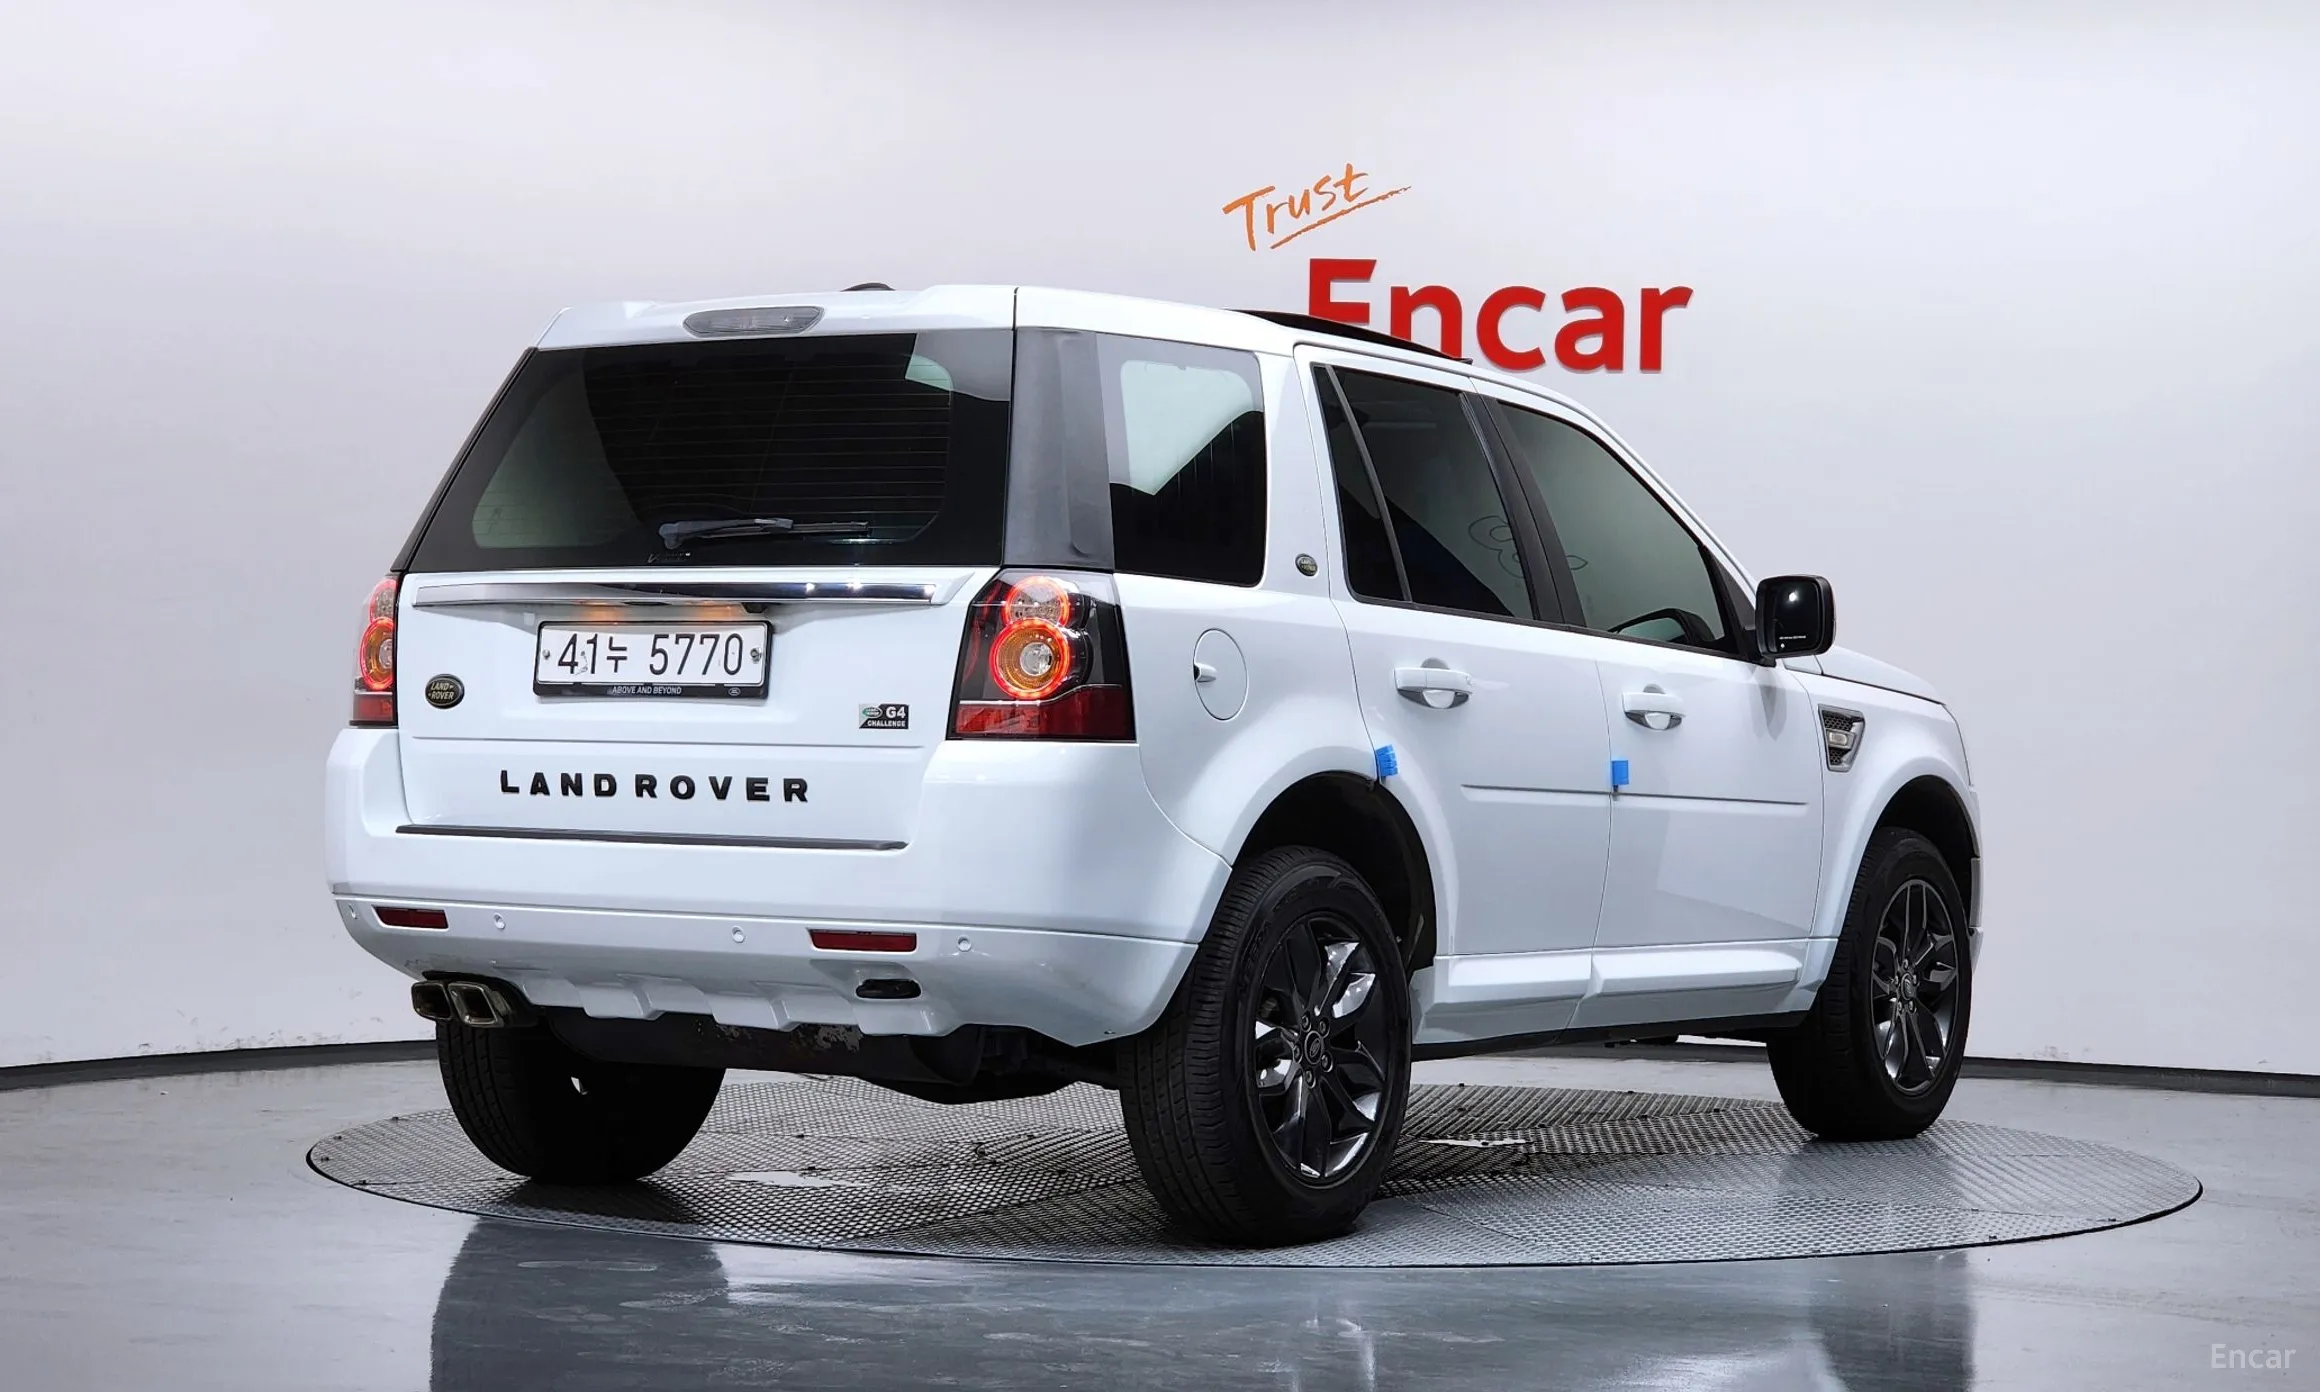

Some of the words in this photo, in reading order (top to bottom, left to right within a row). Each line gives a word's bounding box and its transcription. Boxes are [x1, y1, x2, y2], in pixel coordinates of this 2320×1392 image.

[1222, 163, 1369, 251] Trust
[1309, 258, 1694, 373] Encar
[557, 633, 628, 675] 41누
[649, 633, 744, 676] 5770
[430, 682, 450, 691] LAND
[431, 691, 455, 700] ROVER
[612, 686, 636, 694] ABOVE
[637, 686, 652, 694] AND
[653, 686, 682, 695] BEYOND
[885, 706, 906, 718] G4
[500, 770, 618, 797] LAND
[634, 774, 809, 802] ROVER
